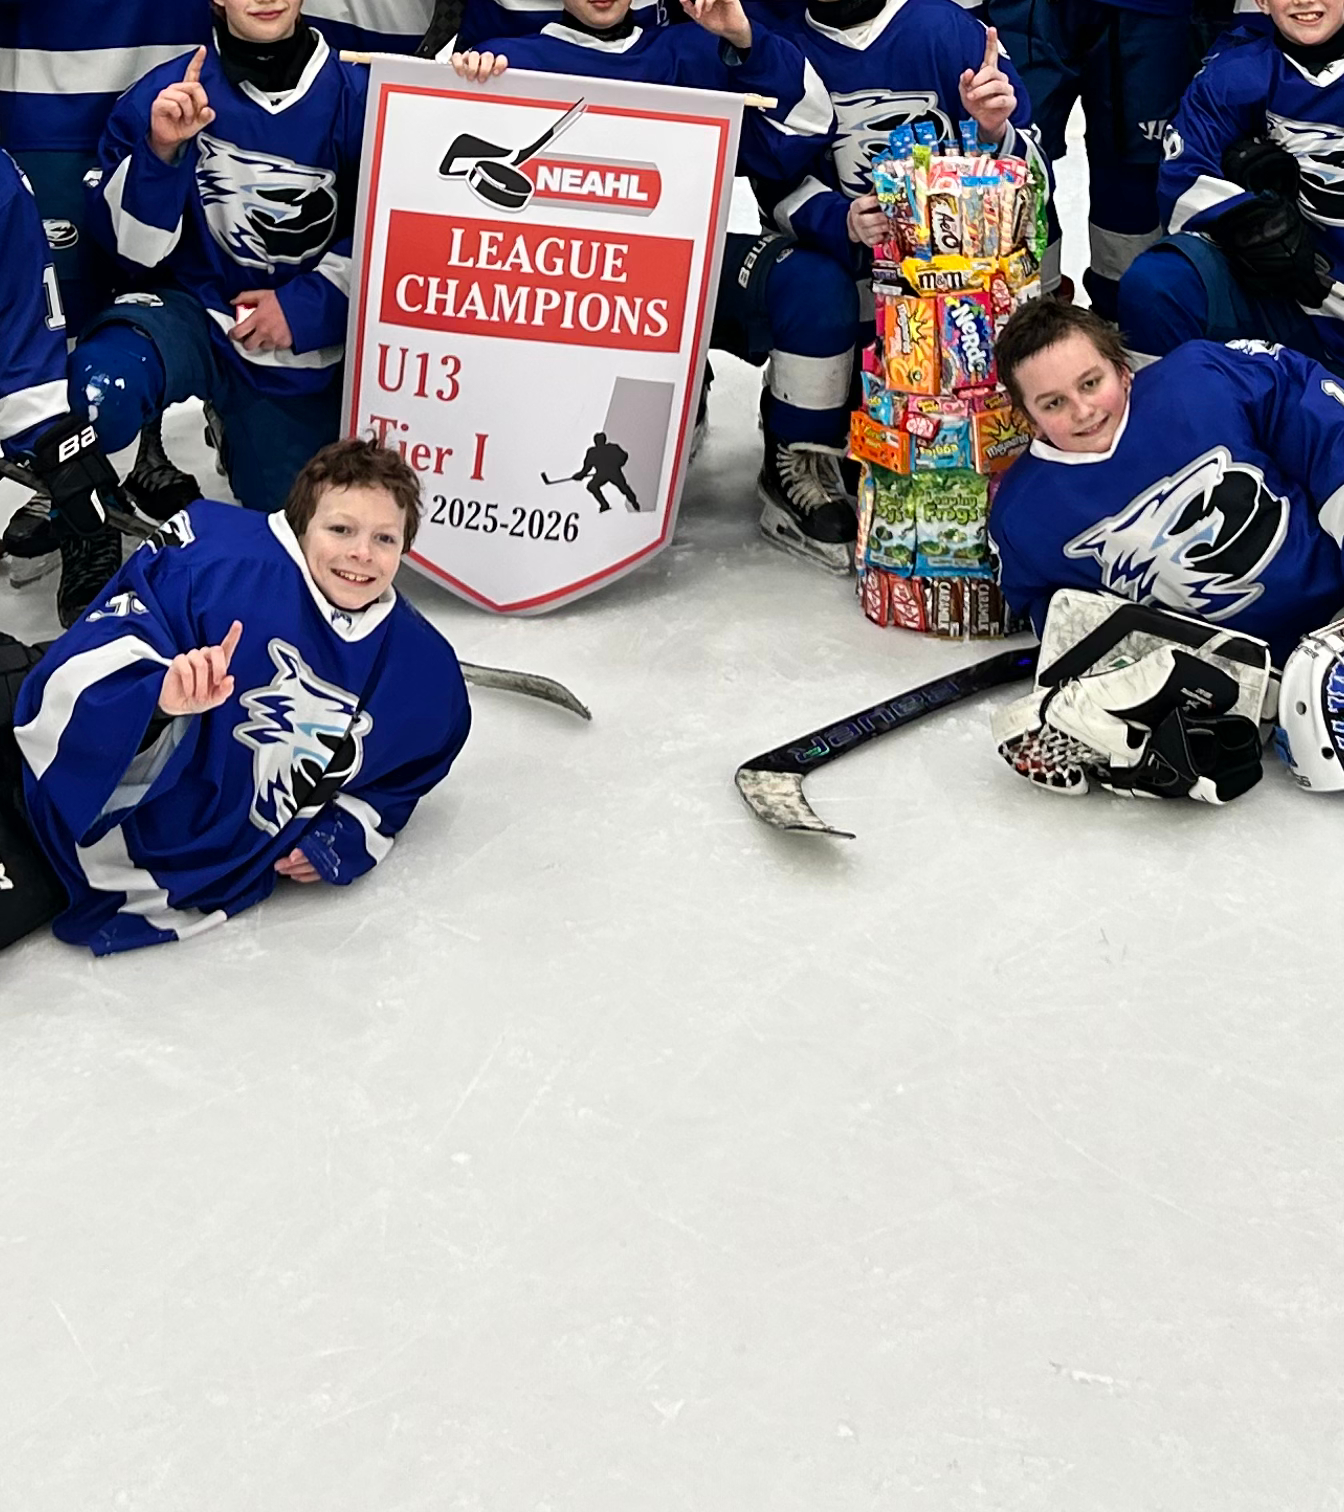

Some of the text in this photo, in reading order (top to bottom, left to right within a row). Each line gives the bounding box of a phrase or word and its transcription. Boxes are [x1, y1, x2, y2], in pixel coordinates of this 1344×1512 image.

[535, 164, 650, 202] NEAHL
[447, 228, 630, 283] LEAGUE
[394, 273, 670, 338] CHAMPIONS
[376, 343, 463, 403] U13
[370, 415, 454, 476] Tier
[430, 494, 581, 544] 2025-2026
